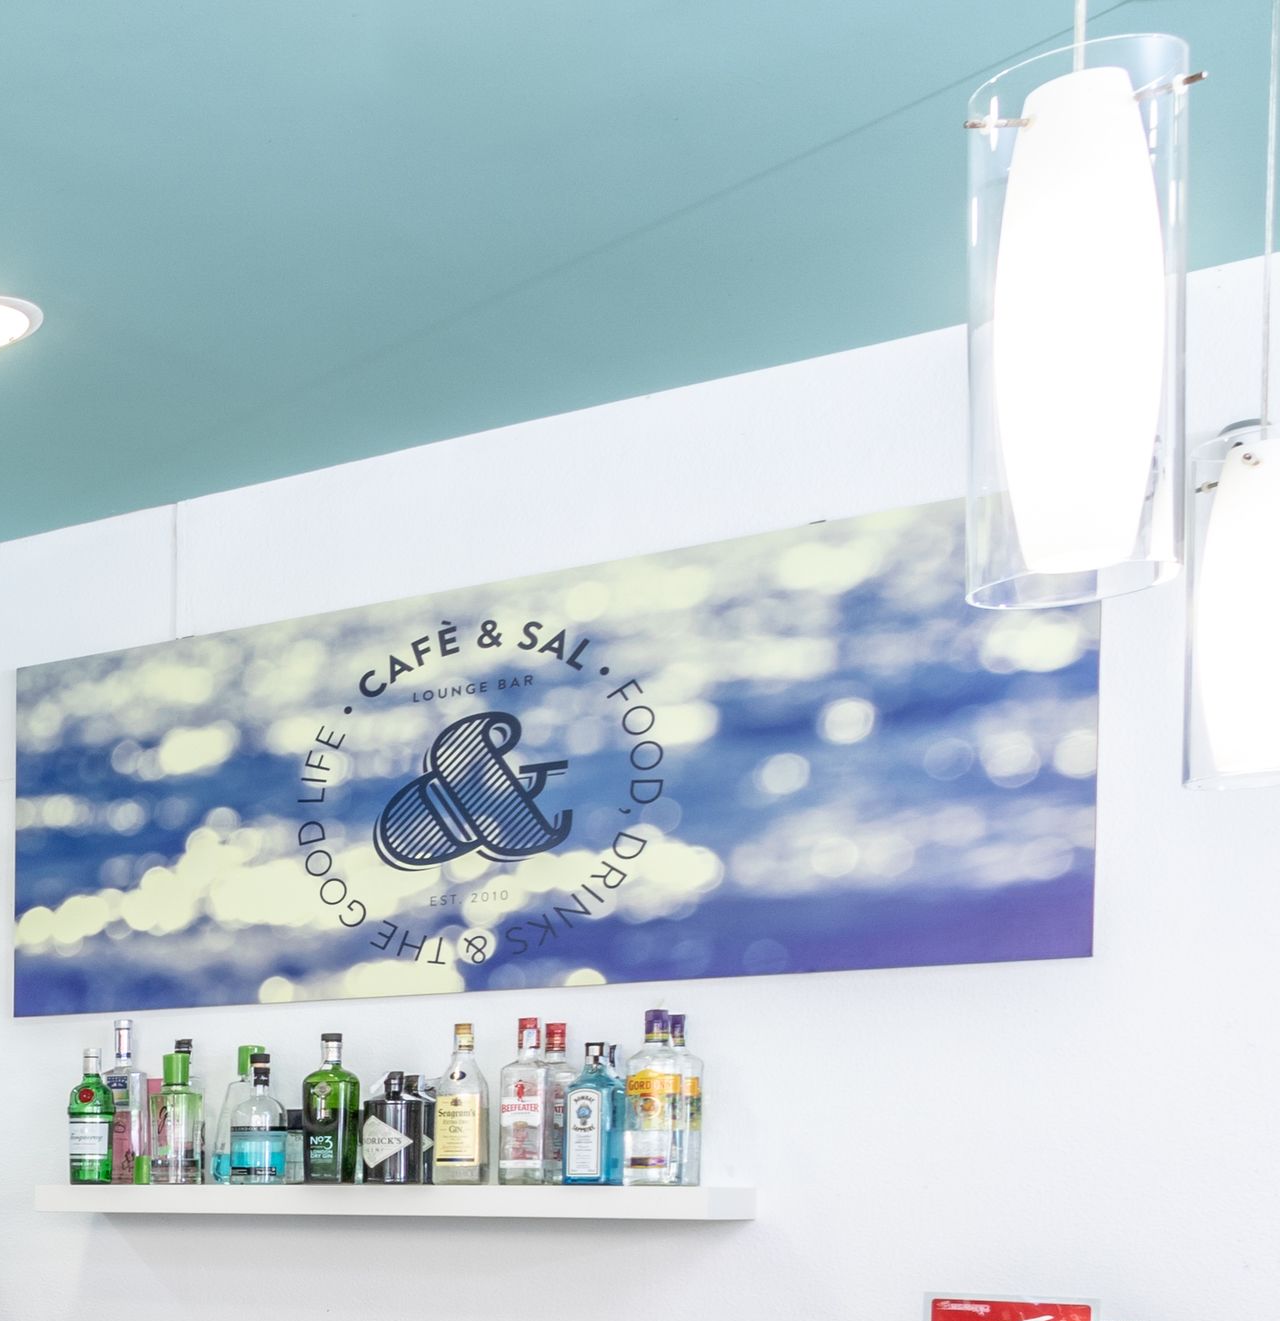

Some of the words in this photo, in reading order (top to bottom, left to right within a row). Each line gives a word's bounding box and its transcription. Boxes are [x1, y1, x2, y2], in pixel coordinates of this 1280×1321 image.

[476, 618, 503, 649] &
[517, 620, 591, 672] SAL
[412, 680, 489, 703] LOUNGE
[498, 674, 535, 691] BAR
[297, 725, 347, 804] LIFE
[297, 820, 367, 928] GOOD
[429, 893, 463, 907] EST.
[470, 889, 510, 904] 2010
[505, 831, 648, 956] DRINKS
[369, 918, 447, 966] THE
[463, 935, 489, 965] &
[438, 1108, 476, 1118] Seagram's
[501, 1104, 539, 1113] BEEFEATER
[363, 1137, 402, 1145] DRICK'S
[449, 1126, 463, 1134] GIN
